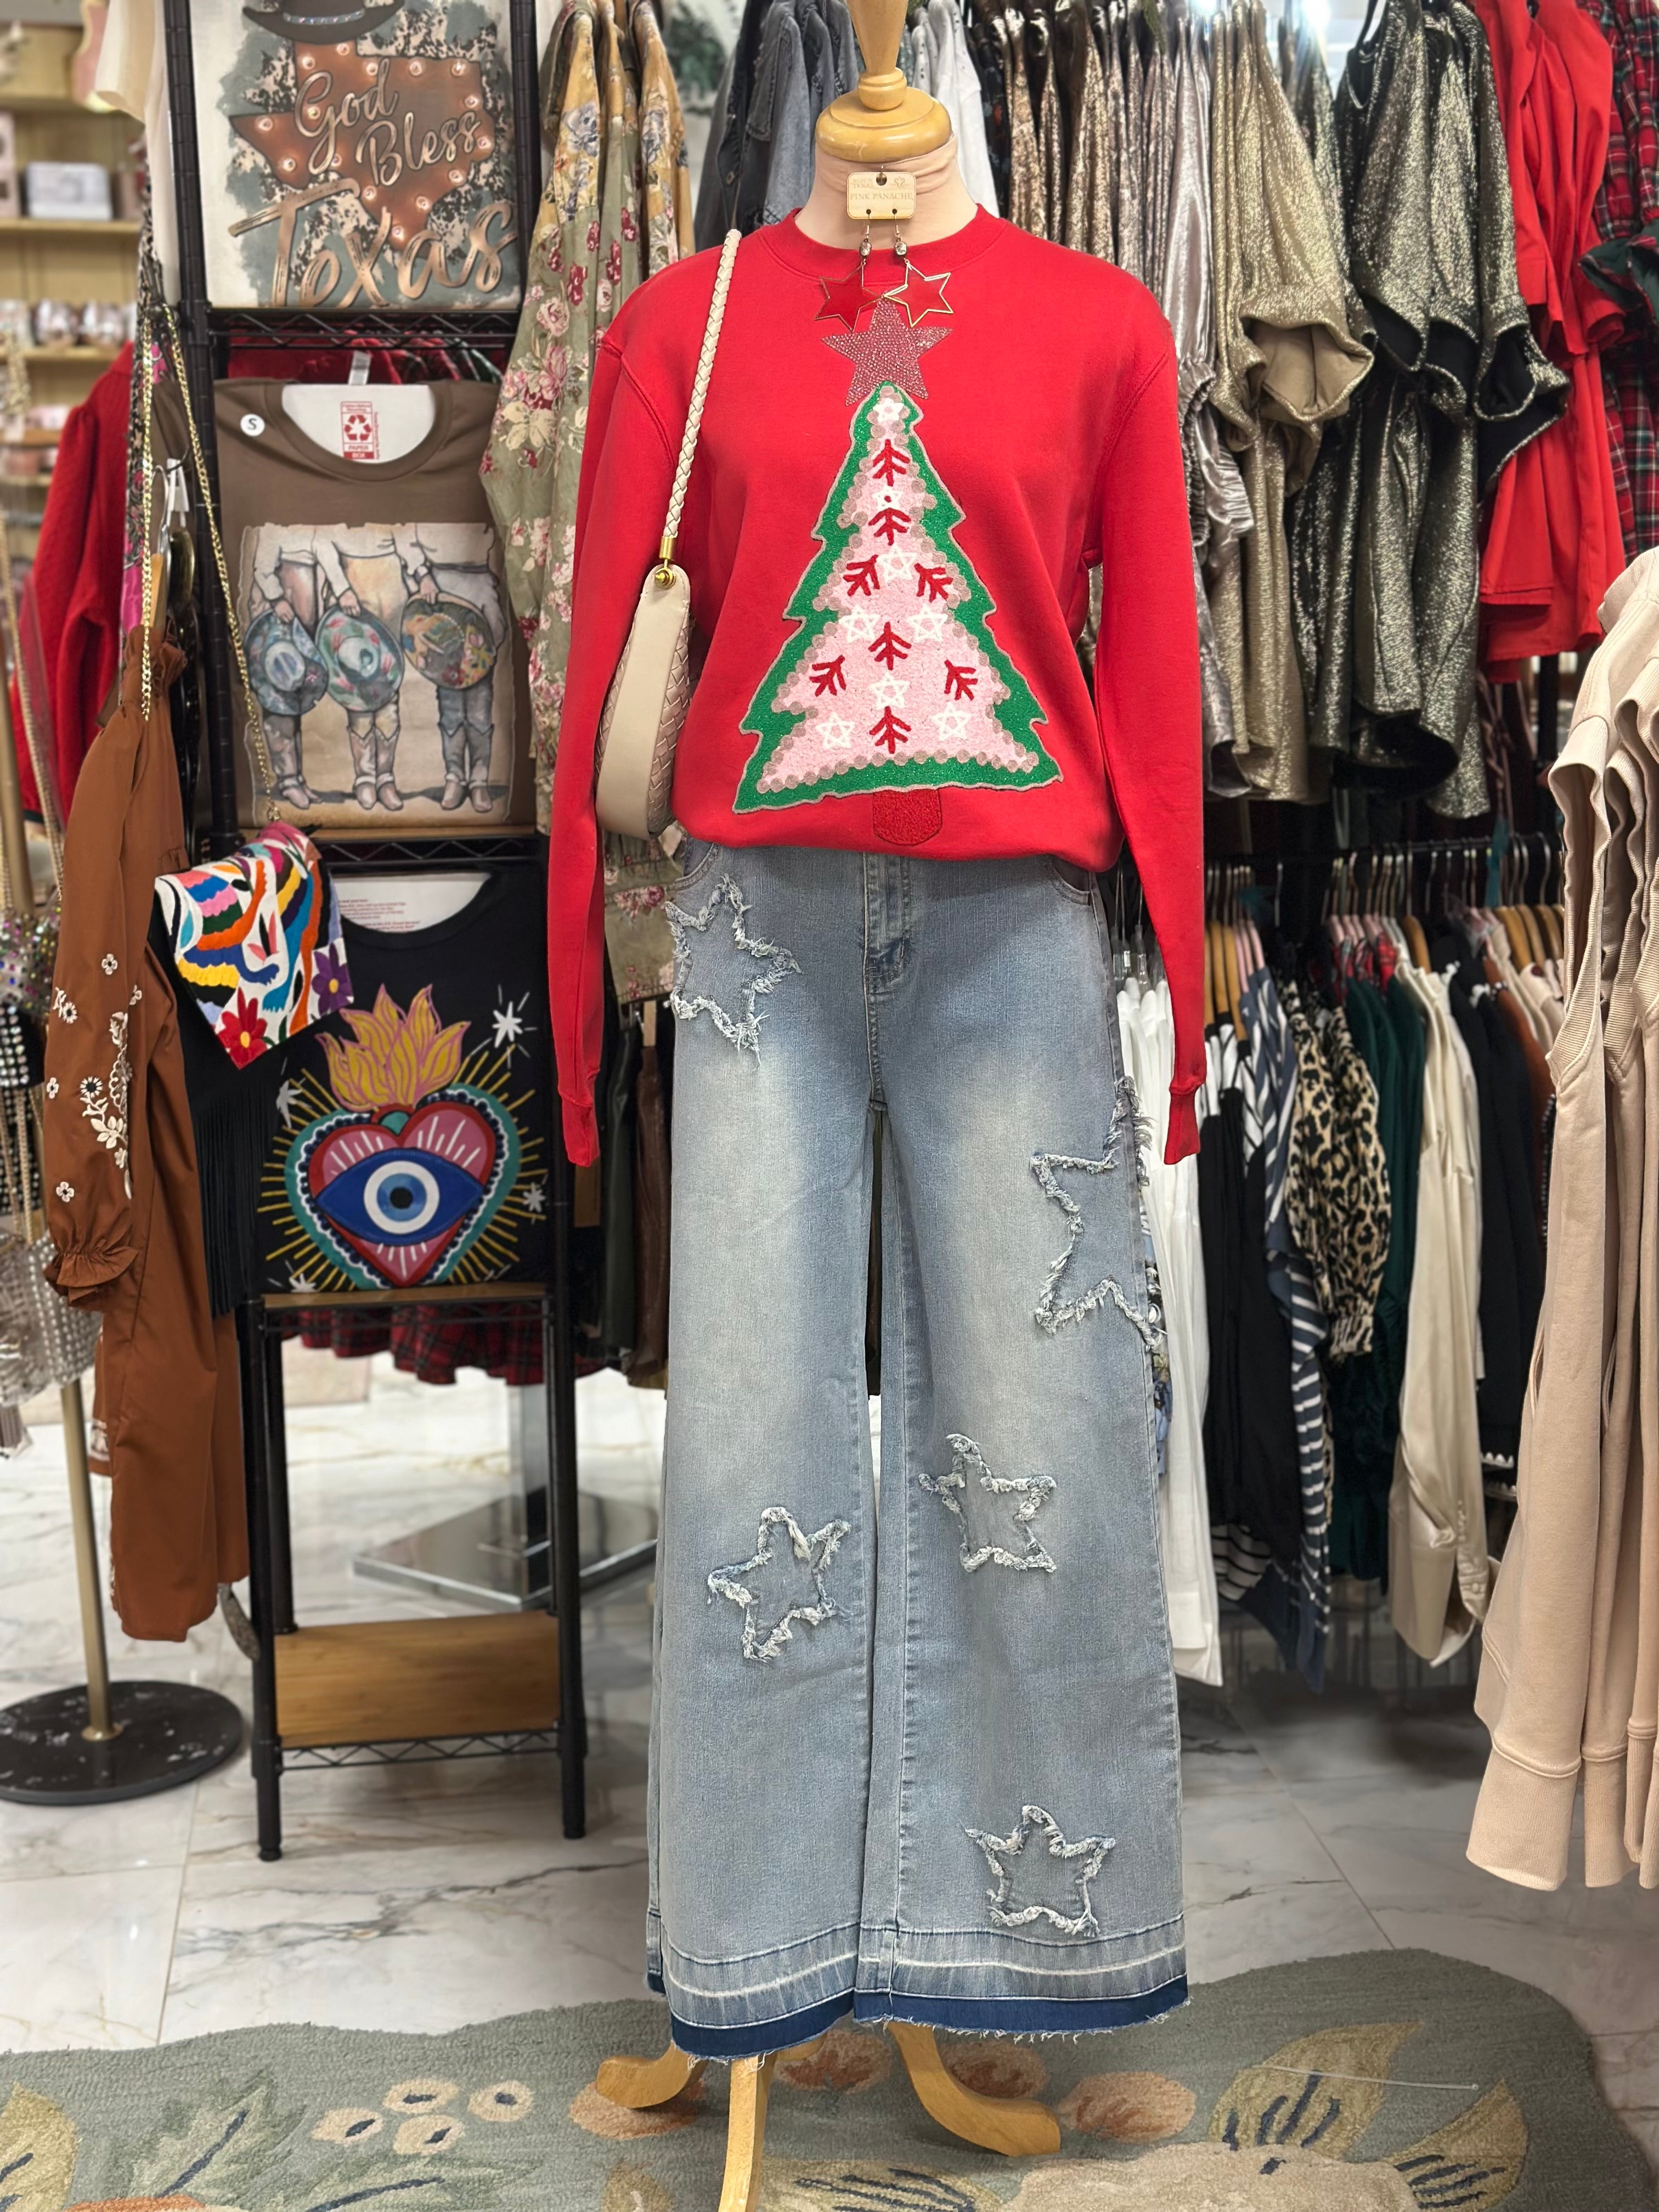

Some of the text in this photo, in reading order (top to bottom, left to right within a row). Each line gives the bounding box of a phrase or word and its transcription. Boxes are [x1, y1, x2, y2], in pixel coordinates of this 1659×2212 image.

[295, 58, 399, 174] God
[356, 111, 482, 187] Bless
[228, 177, 518, 308] Texas
[247, 417, 257, 431] S
